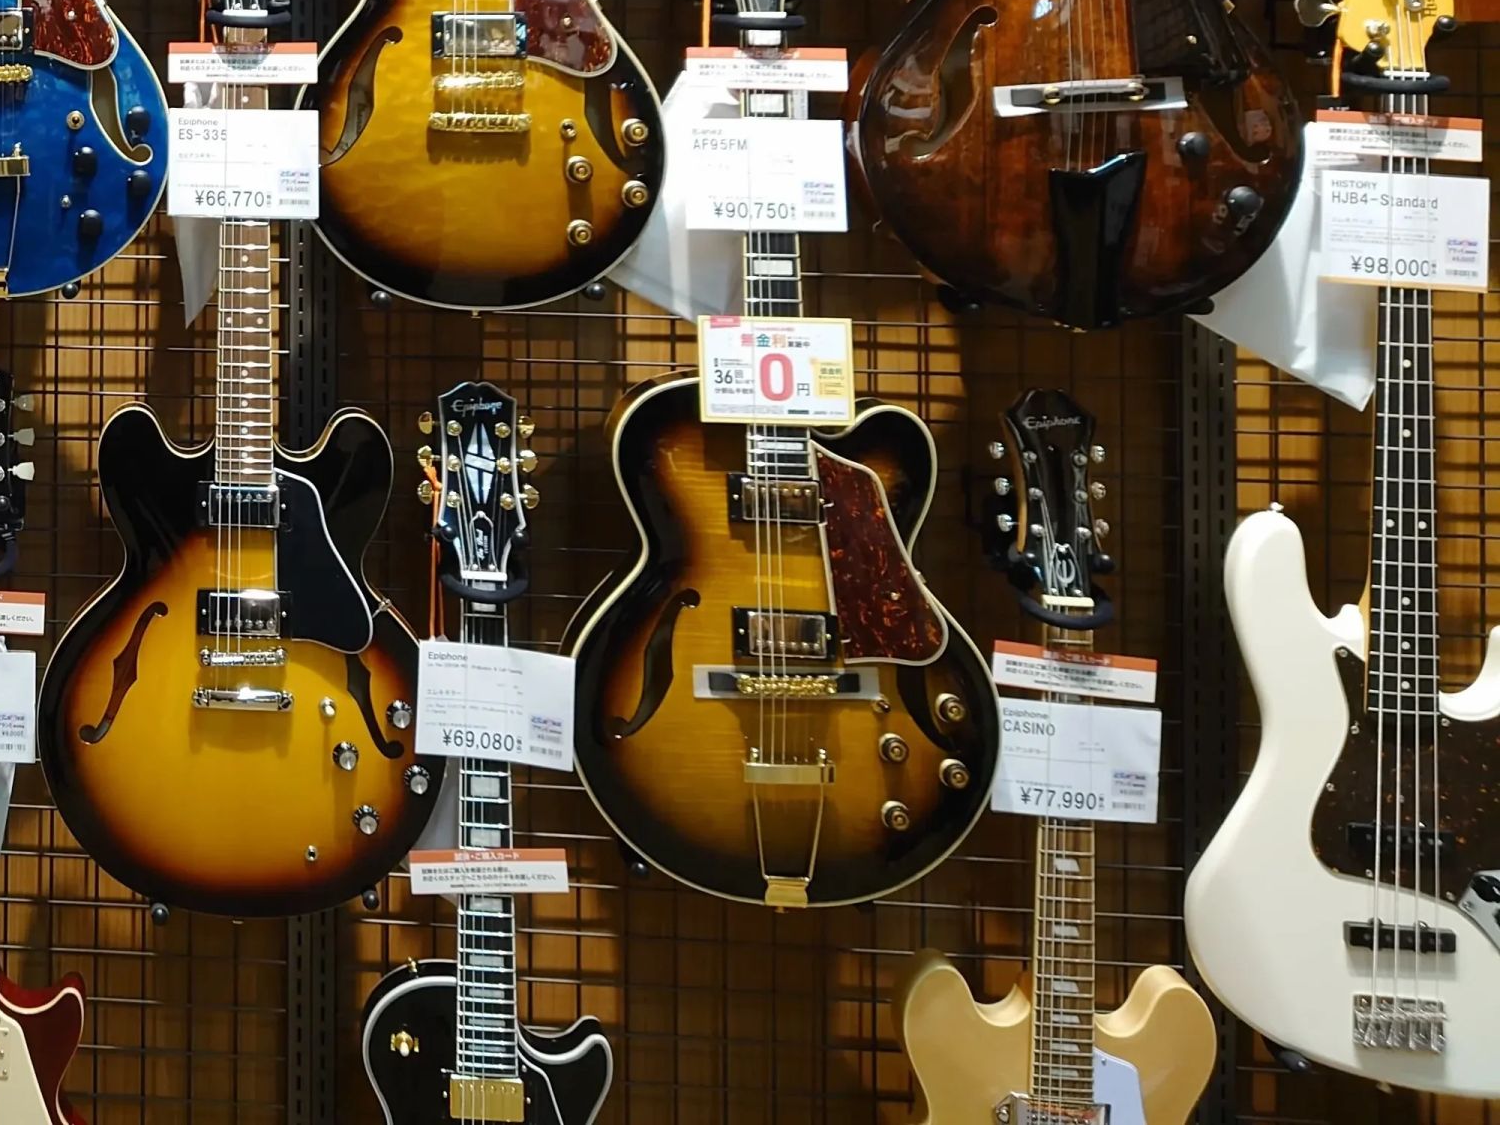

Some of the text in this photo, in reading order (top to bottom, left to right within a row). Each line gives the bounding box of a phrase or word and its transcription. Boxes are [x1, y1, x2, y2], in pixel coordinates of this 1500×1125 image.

[178, 117, 219, 128] Epiphone
[178, 128, 228, 141] ES-335
[692, 138, 748, 151] AF95FM
[1331, 179, 1378, 190] HISTORY
[195, 190, 265, 208] ¥66,770
[712, 201, 789, 220] ¥90,750
[1351, 255, 1432, 277] ¥98,000
[714, 369, 733, 385] 36
[760, 352, 811, 402] 0 円
[450, 396, 503, 418] Epiphone
[1021, 414, 1082, 430] Epiphone
[427, 651, 469, 663] Epiphone
[1002, 707, 1049, 721] Epiphone
[1002, 718, 1056, 737] CASINO
[442, 728, 515, 753] ¥69,080
[1020, 786, 1097, 811] ¥77,990
